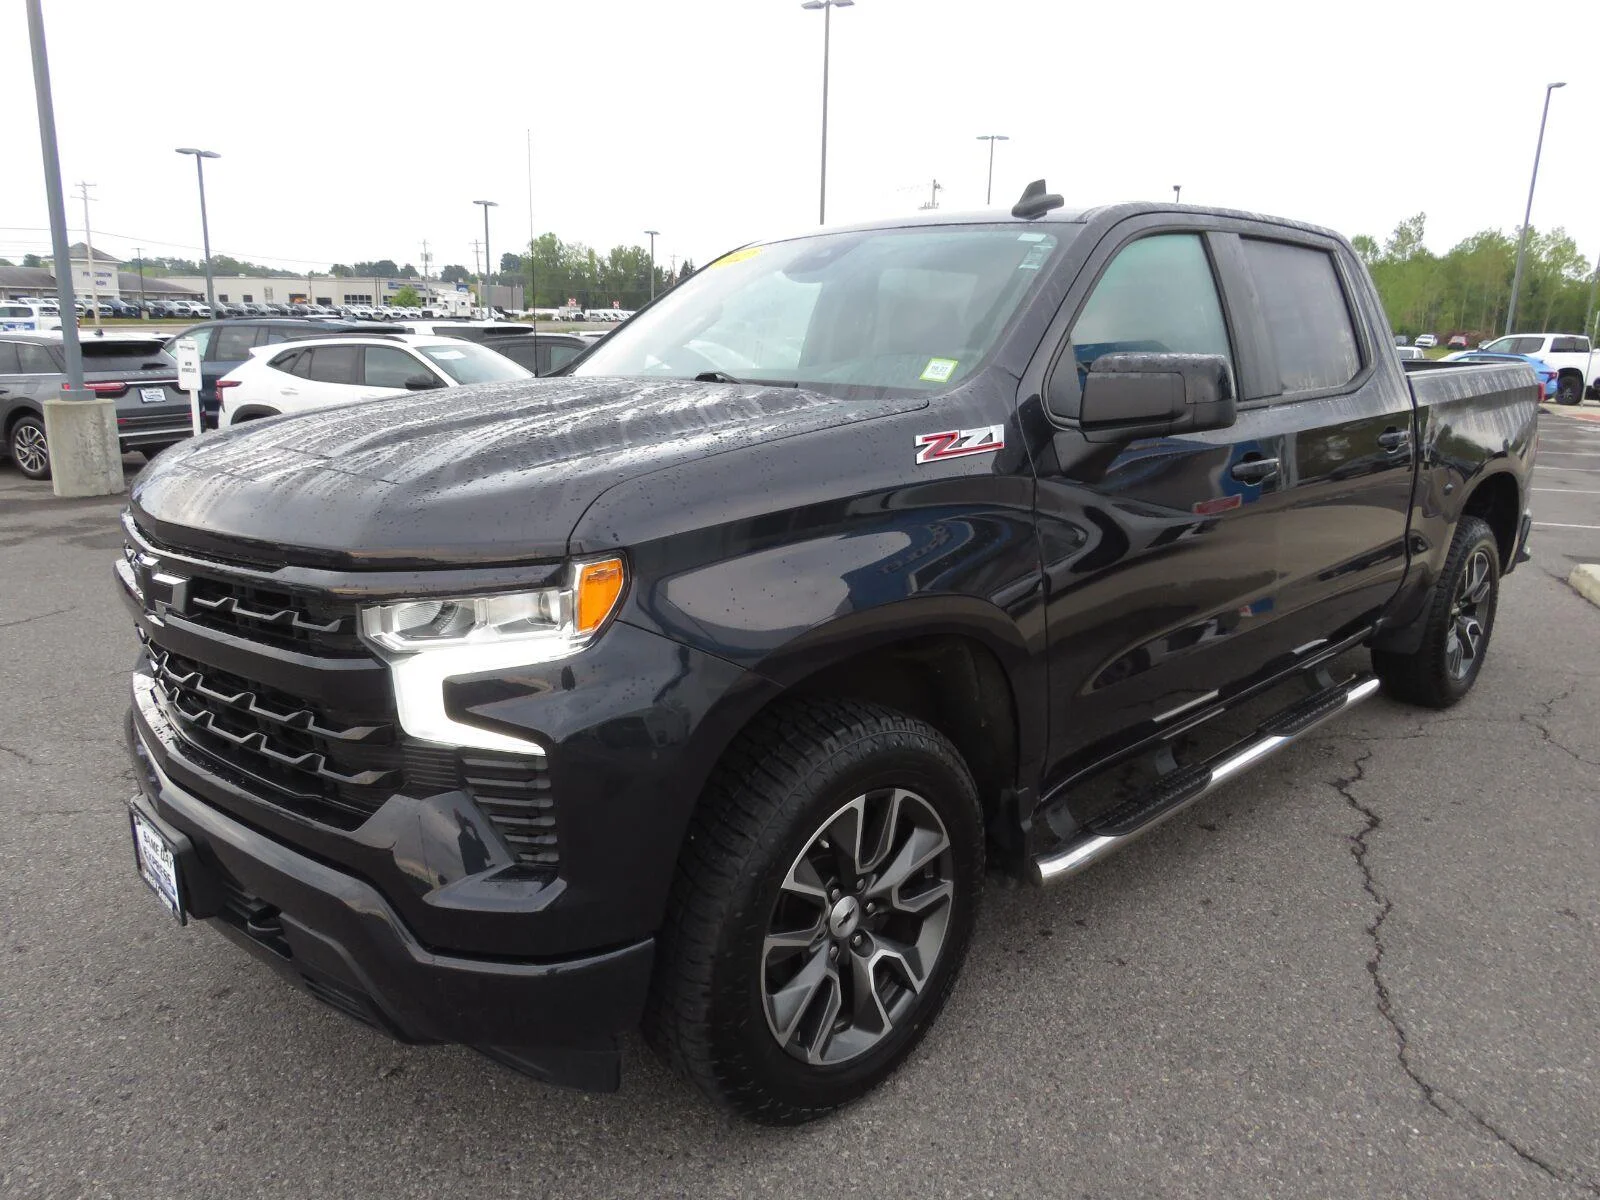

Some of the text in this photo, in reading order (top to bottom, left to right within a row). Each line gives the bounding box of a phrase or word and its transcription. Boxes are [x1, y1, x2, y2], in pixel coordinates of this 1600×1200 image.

[914, 424, 1005, 465] Z71
[143, 830, 174, 869] SAME DAY
